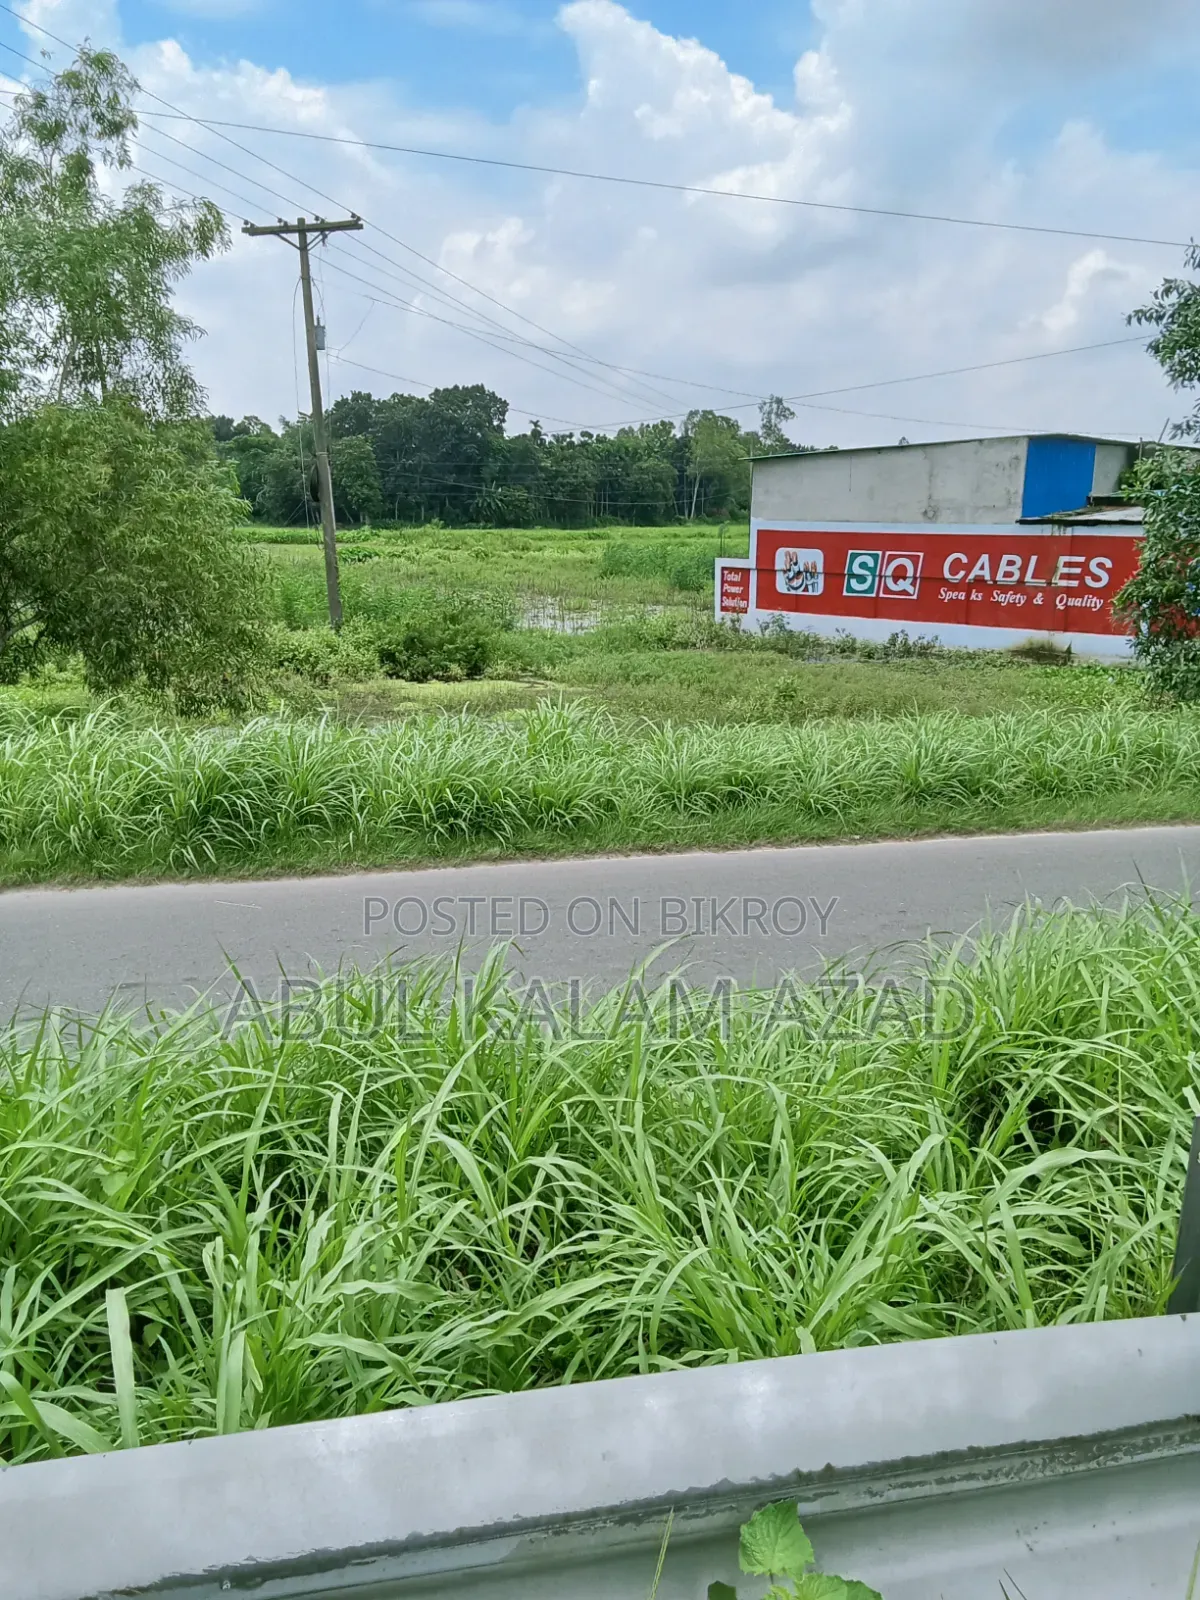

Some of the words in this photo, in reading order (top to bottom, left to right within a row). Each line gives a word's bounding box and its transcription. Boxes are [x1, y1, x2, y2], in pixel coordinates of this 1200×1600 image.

[722, 570, 742, 581] Total
[942, 552, 1113, 588] CABLES
[722, 583, 744, 594] Power
[721, 596, 747, 608] Solution
[990, 590, 1026, 606] Safety
[1033, 593, 1044, 605] &
[1055, 593, 1104, 610] Quality
